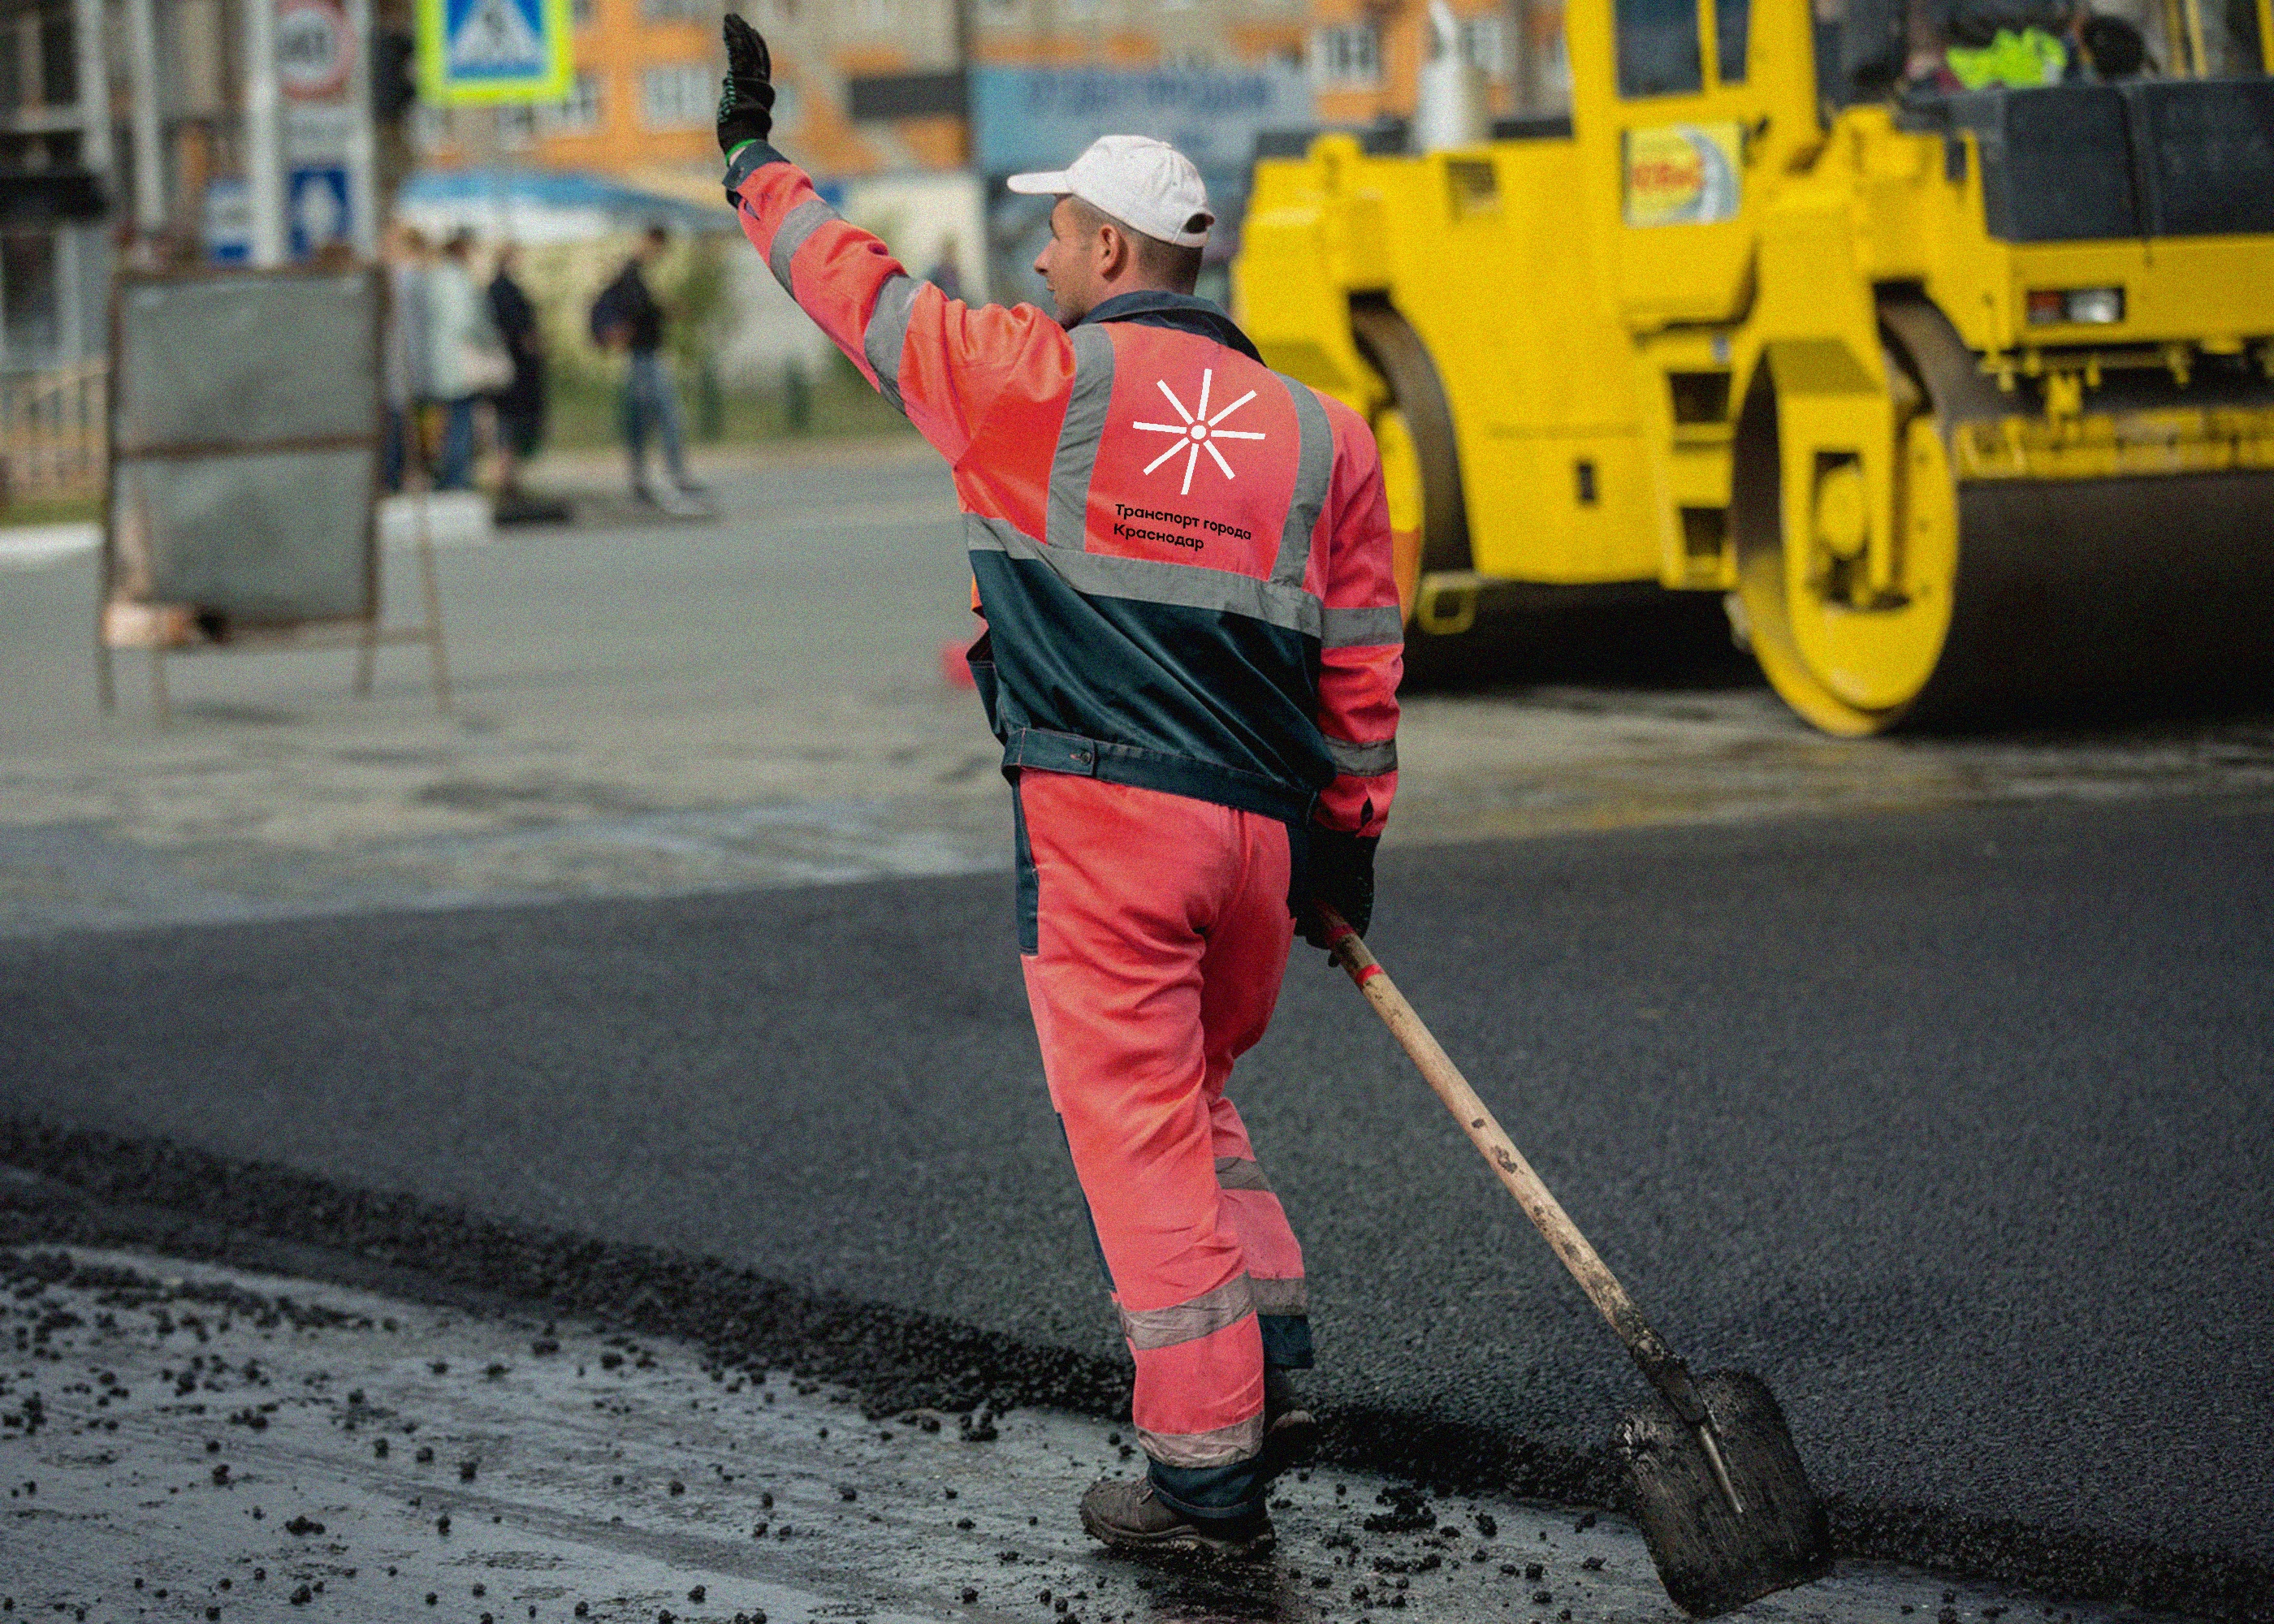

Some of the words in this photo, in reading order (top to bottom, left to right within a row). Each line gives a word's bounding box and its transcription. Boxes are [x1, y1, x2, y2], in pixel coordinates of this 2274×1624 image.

[1113, 523, 1204, 551] Краснодар
[1115, 503, 1200, 529] Транспорт
[1204, 520, 1252, 540] города
